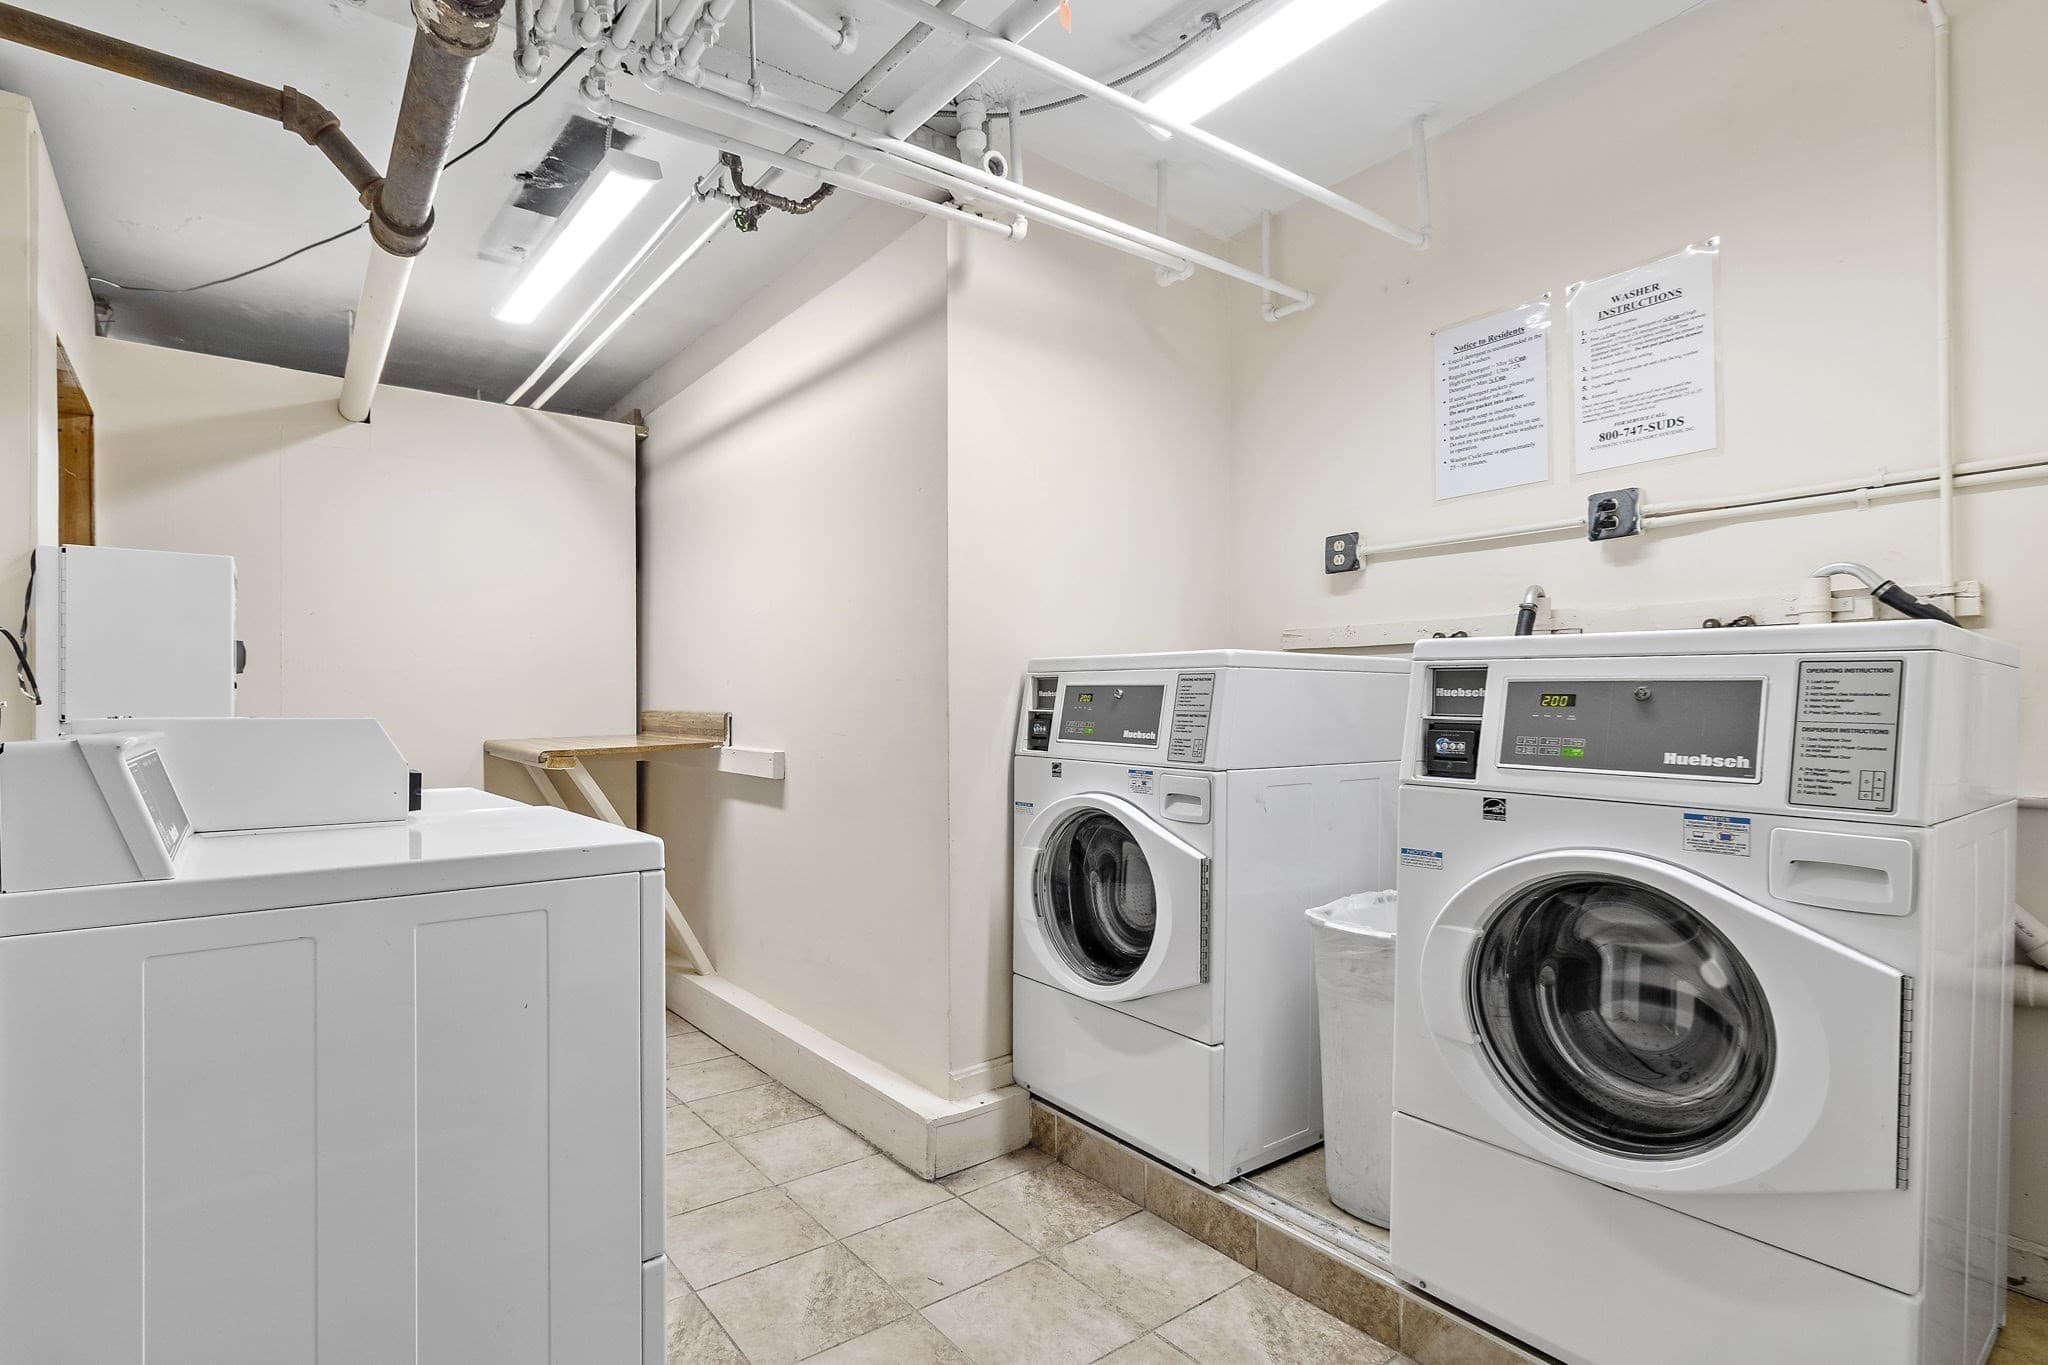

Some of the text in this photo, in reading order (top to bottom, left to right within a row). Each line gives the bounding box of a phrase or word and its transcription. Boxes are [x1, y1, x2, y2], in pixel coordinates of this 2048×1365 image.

[1611, 283, 1660, 303] WASHER
[1598, 288, 1683, 320] INSTRUCTIONS
[1454, 327, 1524, 352] Notice to Residents
[1448, 372, 1466, 380] Regular
[1467, 365, 1489, 375] Detergent
[1448, 384, 1470, 393] Detergent
[1475, 402, 1492, 410] packet
[1598, 416, 1685, 443] 800-747-SUDS
[1542, 695, 1568, 706] 200
[1123, 730, 1155, 739] Huebsch
[1664, 752, 1750, 768] Huebsch
[1703, 815, 1729, 823] NOTICE
[1407, 849, 1434, 857] NOTICE
